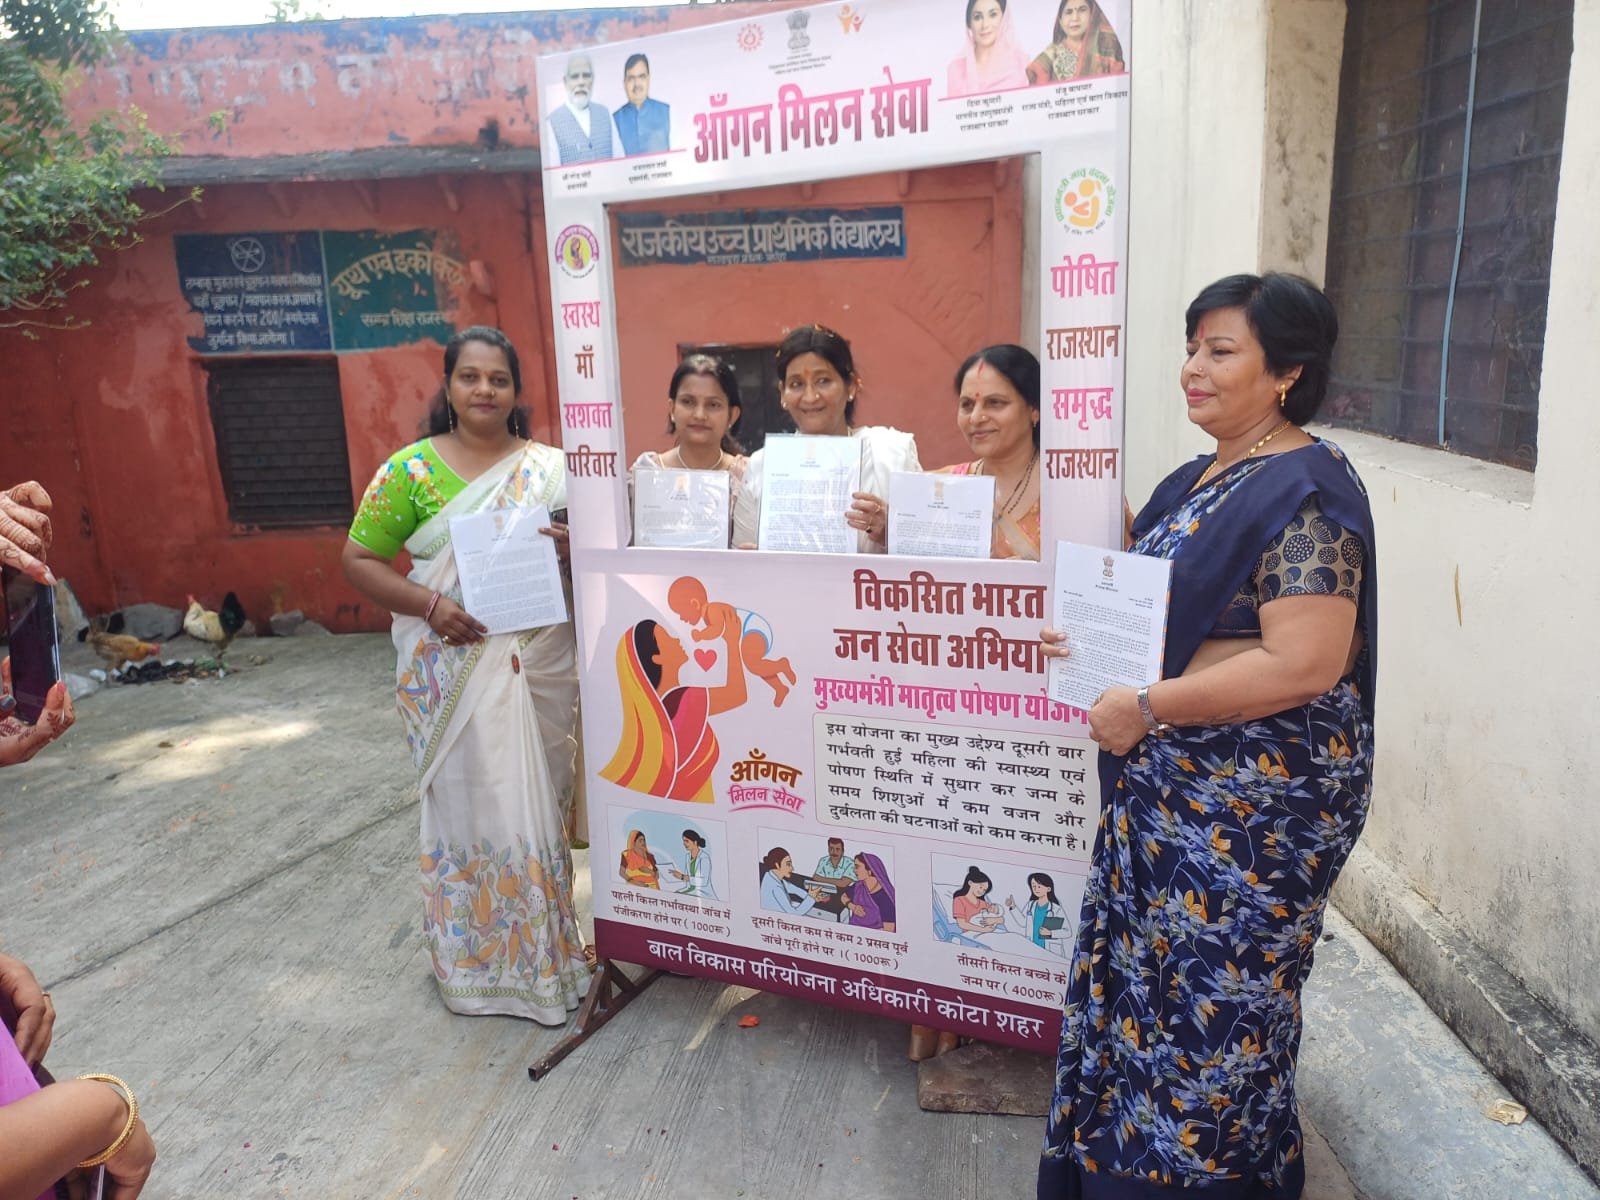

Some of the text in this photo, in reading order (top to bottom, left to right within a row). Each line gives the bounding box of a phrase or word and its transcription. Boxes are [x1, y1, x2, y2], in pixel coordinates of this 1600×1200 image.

[694, 66, 932, 163] आँगन मिलन सेवा
[751, 217, 829, 253] प्राथमिक
[830, 215, 902, 250] विद्यालय
[1050, 253, 1119, 298] पोषित
[561, 301, 600, 329] स्वस्थ
[575, 344, 594, 379] माँ
[1046, 325, 1121, 360] राजस्थान
[1051, 387, 1114, 431] समृद्ध
[566, 444, 617, 478] परिवार
[1045, 448, 1119, 480] राजस्थान
[853, 569, 1047, 619] विकसित भारत
[833, 628, 881, 662] जन
[886, 621, 941, 667] सेवा
[947, 627, 1046, 674] अभिया
[813, 674, 895, 711] मुख्यमंत्री
[898, 683, 957, 720] मातृत्व
[960, 682, 1020, 719] पोषण
[826, 723, 1086, 760] इस योजना का मुख्य उद्देश्य दूसरी बार
[730, 747, 803, 788] आँगन
[827, 742, 1086, 786] गर्भवती हुई महिला की स्वास्थ्य एवं
[827, 761, 1086, 805] पोषण स्थिति में सुधार कर जन्म के
[727, 784, 806, 811] मिलन सेवा
[828, 784, 1086, 828] समय शिशुओं में कम वजन और
[828, 803, 876, 820] दुर्बलता
[879, 809, 900, 824] की
[902, 814, 960, 833] घटनाओं
[962, 820, 984, 835] को
[987, 825, 1016, 840] कम
[1019, 830, 1062, 847] करना
[670, 916, 682, 927] पर
[751, 916, 909, 957] दूसरी किस्त कम से कम 2 प्रसव पूर्व
[785, 937, 800, 952] पूरी
[822, 946, 835, 956] पर
[647, 939, 1044, 1039] बाल विकास परियोजना अधिकारी कोटा शहर
[957, 952, 1067, 985] तीसरी किस्त बच्चे के
[960, 974, 983, 988] जन्म
[985, 979, 1000, 992] पर
